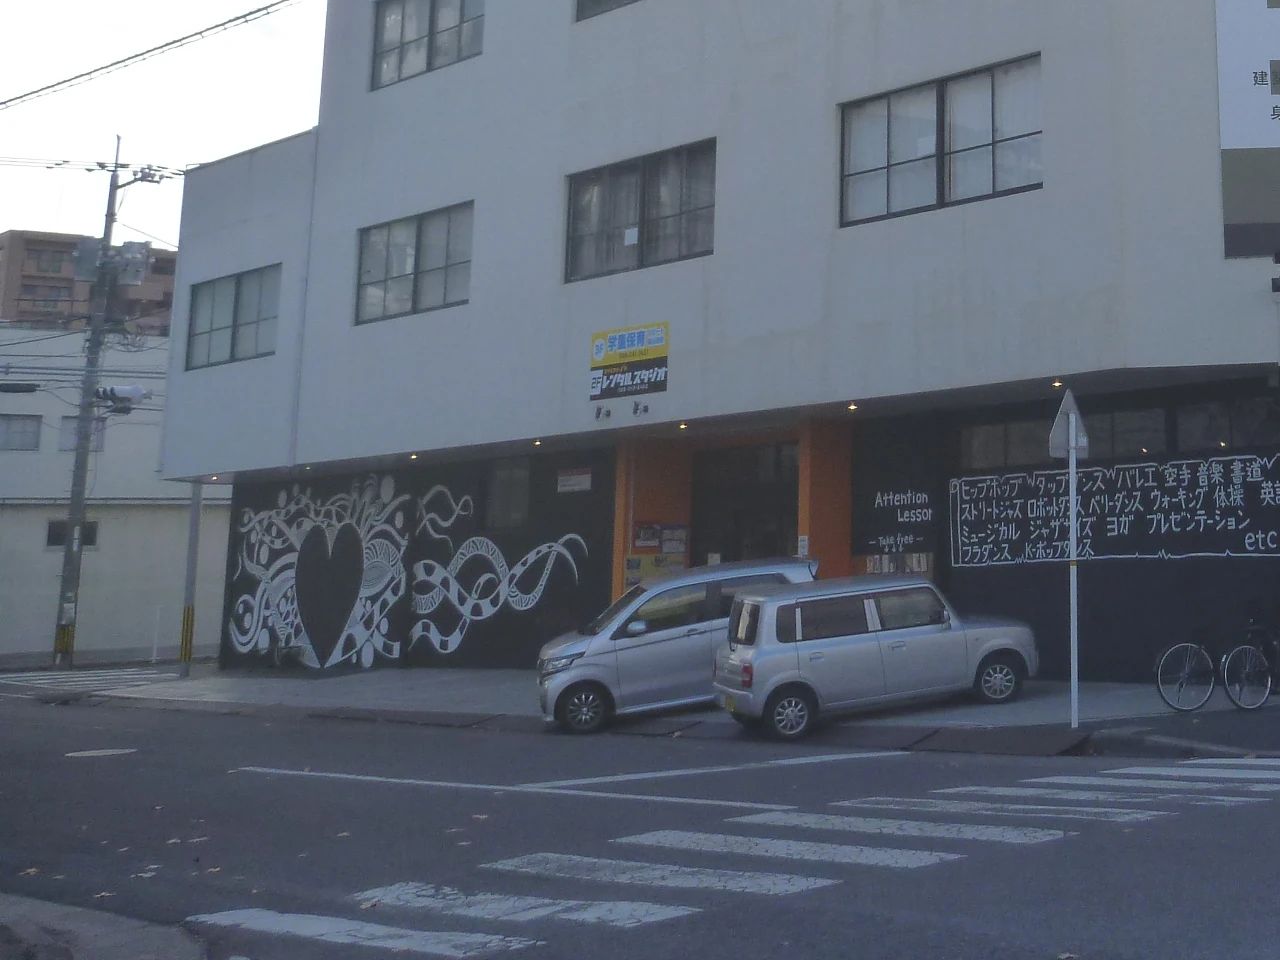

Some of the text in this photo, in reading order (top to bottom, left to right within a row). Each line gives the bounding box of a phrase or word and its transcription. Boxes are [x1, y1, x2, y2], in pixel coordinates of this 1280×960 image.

[1036, 472, 1106, 494] タップンス
[1117, 467, 1158, 488] バレエ
[1164, 465, 1191, 487] 空手
[1197, 462, 1224, 486] 音楽
[1230, 461, 1265, 483] 書道
[874, 489, 929, 508] Attention
[1213, 483, 1245, 508] 体操
[1106, 514, 1135, 536] ヨガ
[1244, 530, 1278, 551] etc
